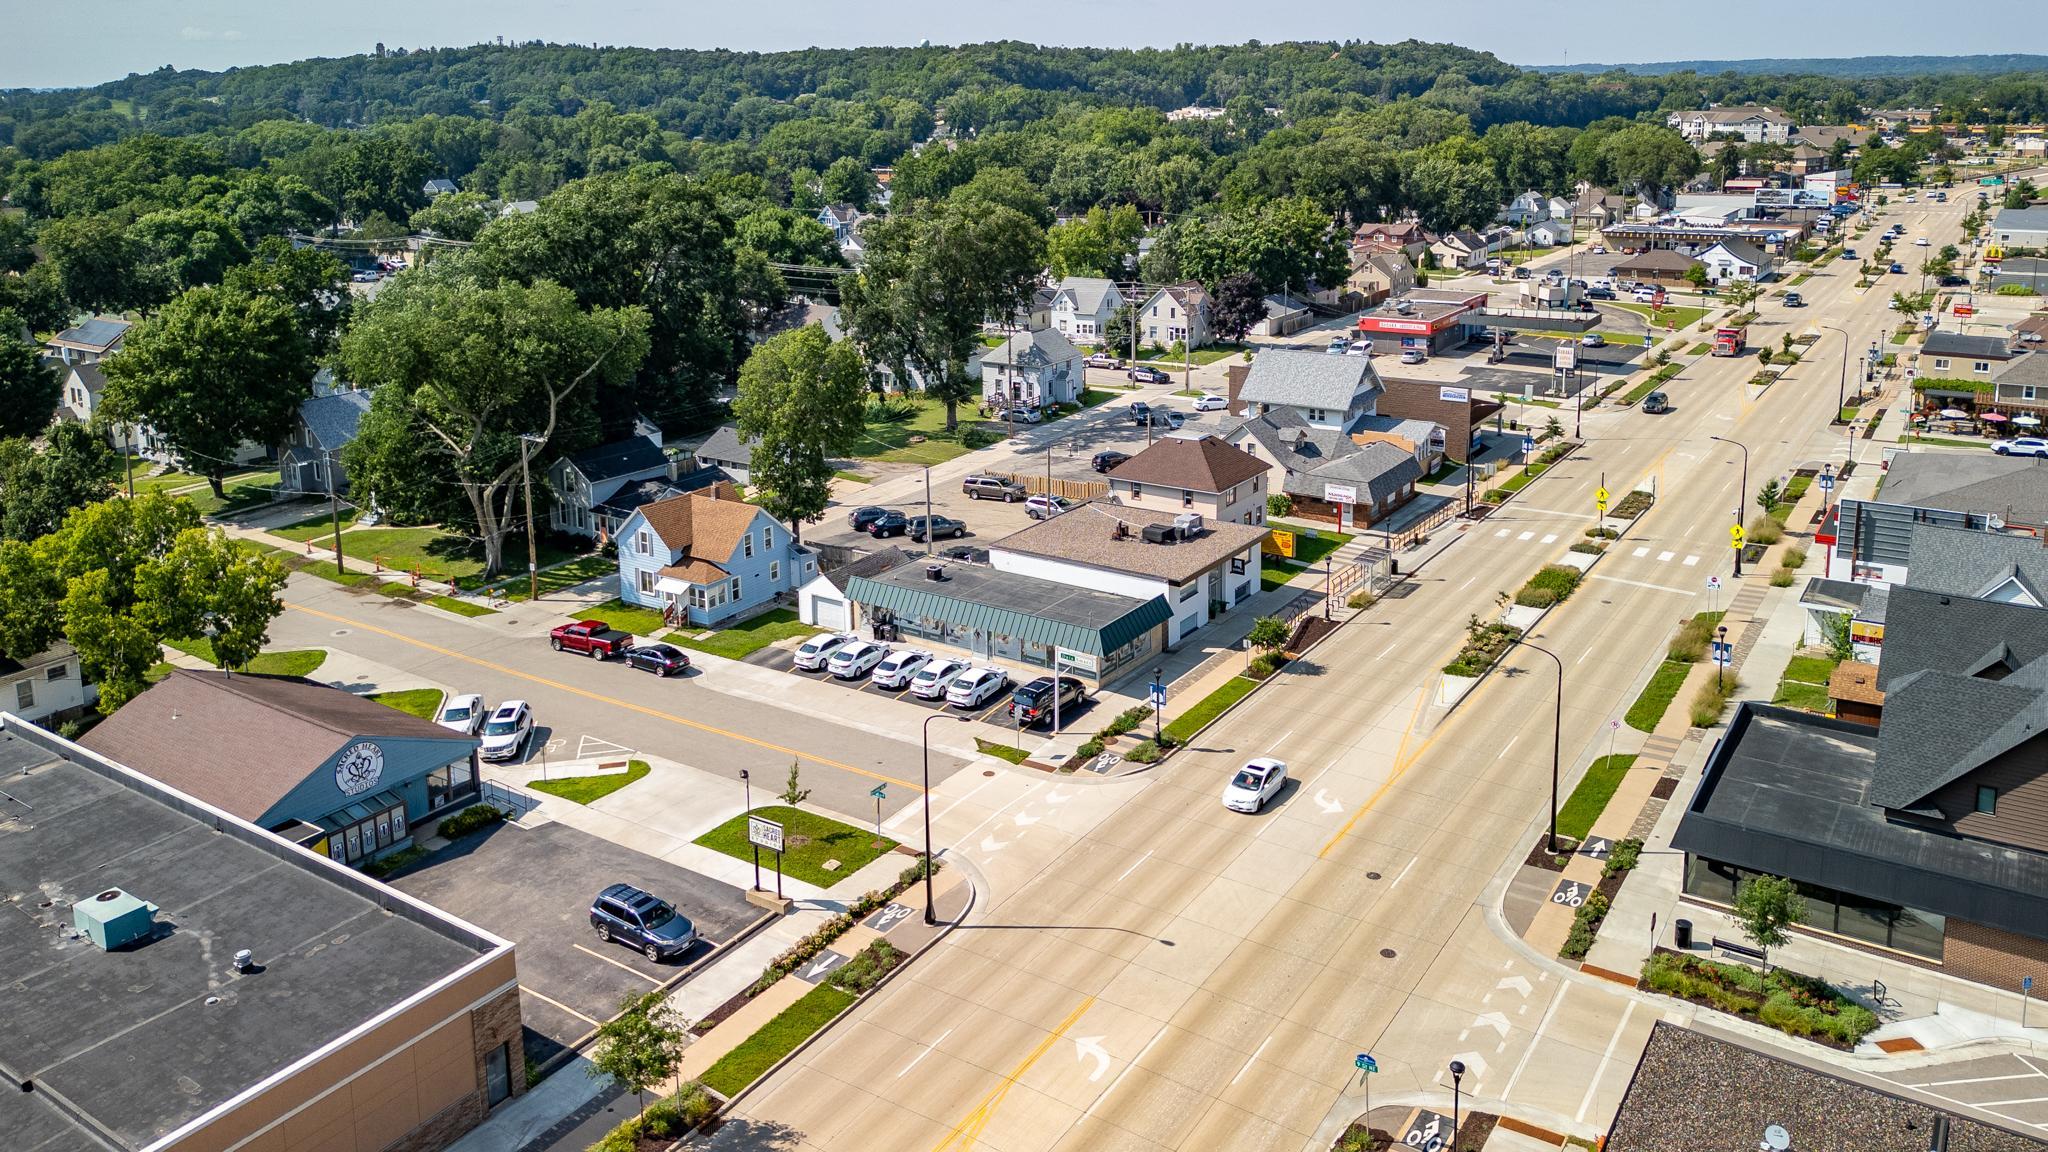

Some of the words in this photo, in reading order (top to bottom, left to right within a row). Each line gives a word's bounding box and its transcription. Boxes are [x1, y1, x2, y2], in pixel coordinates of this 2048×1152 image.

[1852, 634, 1866, 642] THE
[336, 745, 359, 774] SACRED
[362, 743, 383, 758] HEART
[346, 776, 379, 795] STUDIOS
[763, 824, 781, 836] SACRED
[763, 831, 781, 844] HEART
